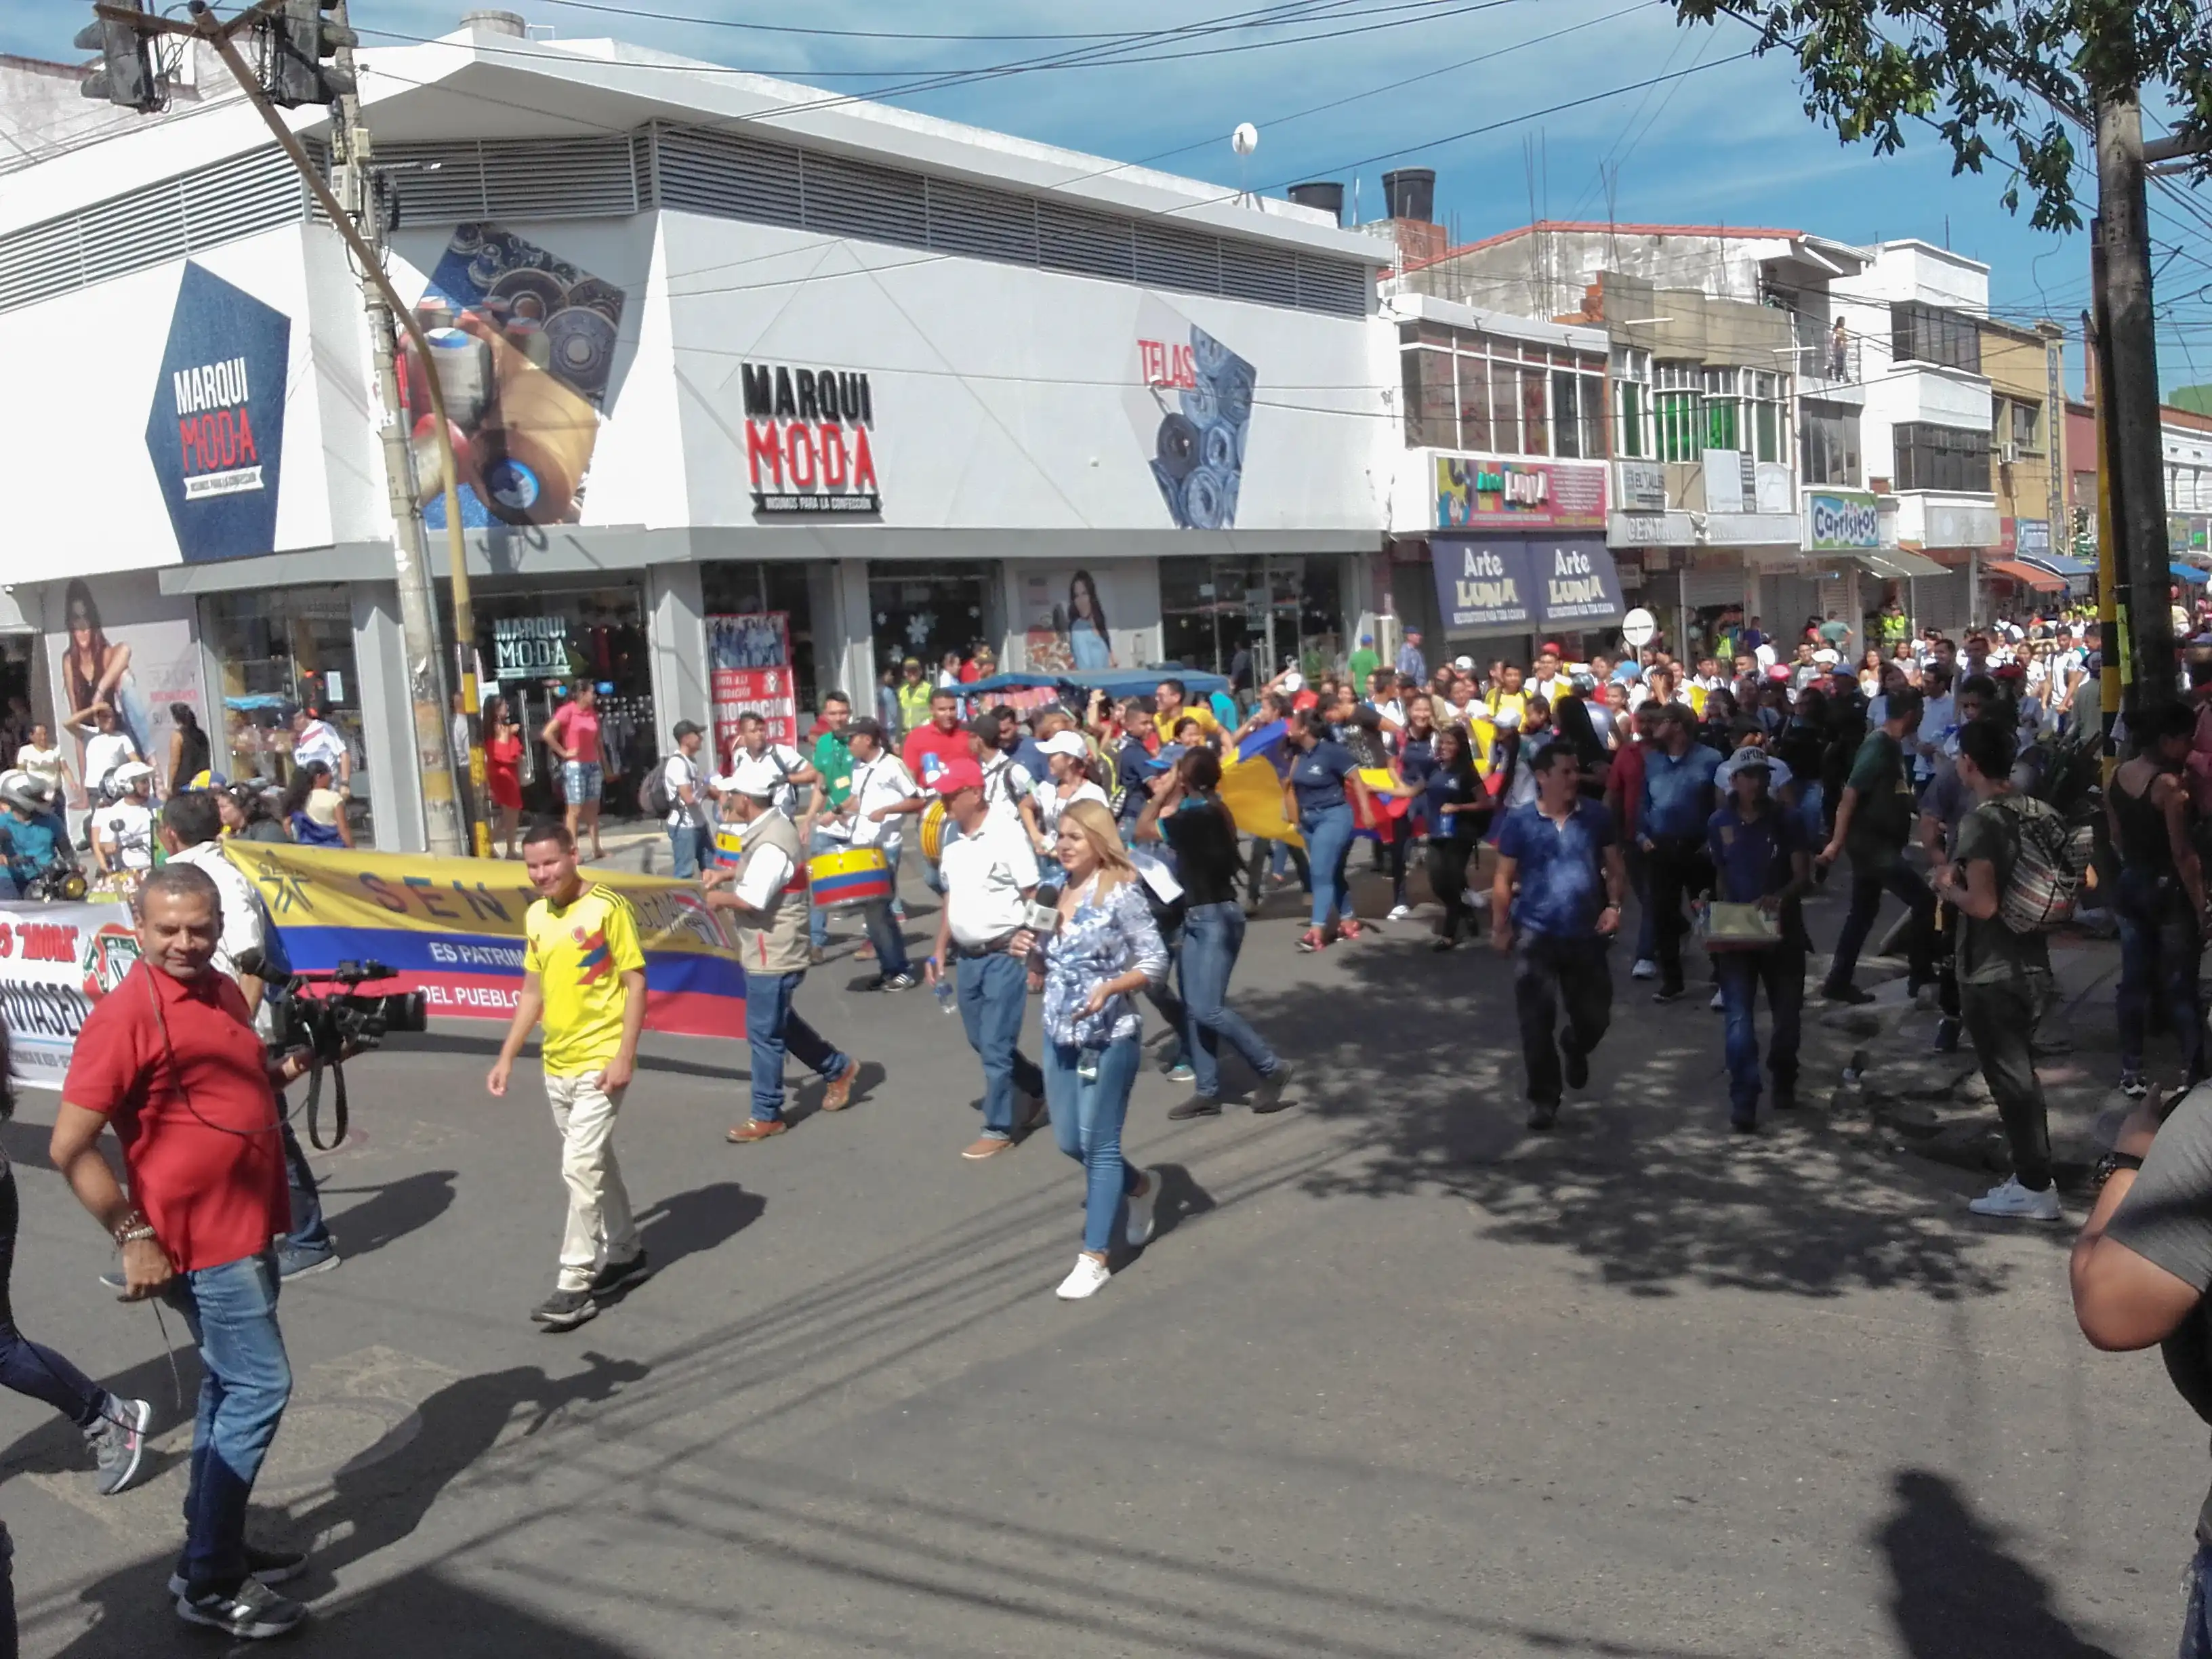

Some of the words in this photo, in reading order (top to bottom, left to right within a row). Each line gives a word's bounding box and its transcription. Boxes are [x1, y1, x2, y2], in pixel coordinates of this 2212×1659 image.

[1137, 340, 1196, 390] TELAS
[173, 356, 249, 415] MARQUI
[741, 363, 872, 422] MARQUI
[179, 407, 258, 472] MODA
[745, 419, 878, 487] MODA
[1465, 548, 1503, 577] Arte
[1555, 548, 1591, 576] Arte
[1456, 578, 1519, 608] LUNA
[1548, 575, 1605, 605] LUNA
[494, 616, 566, 640] MARQUI
[495, 639, 568, 668] MODA
[429, 941, 458, 964] ES
[417, 985, 453, 1004] DEL
